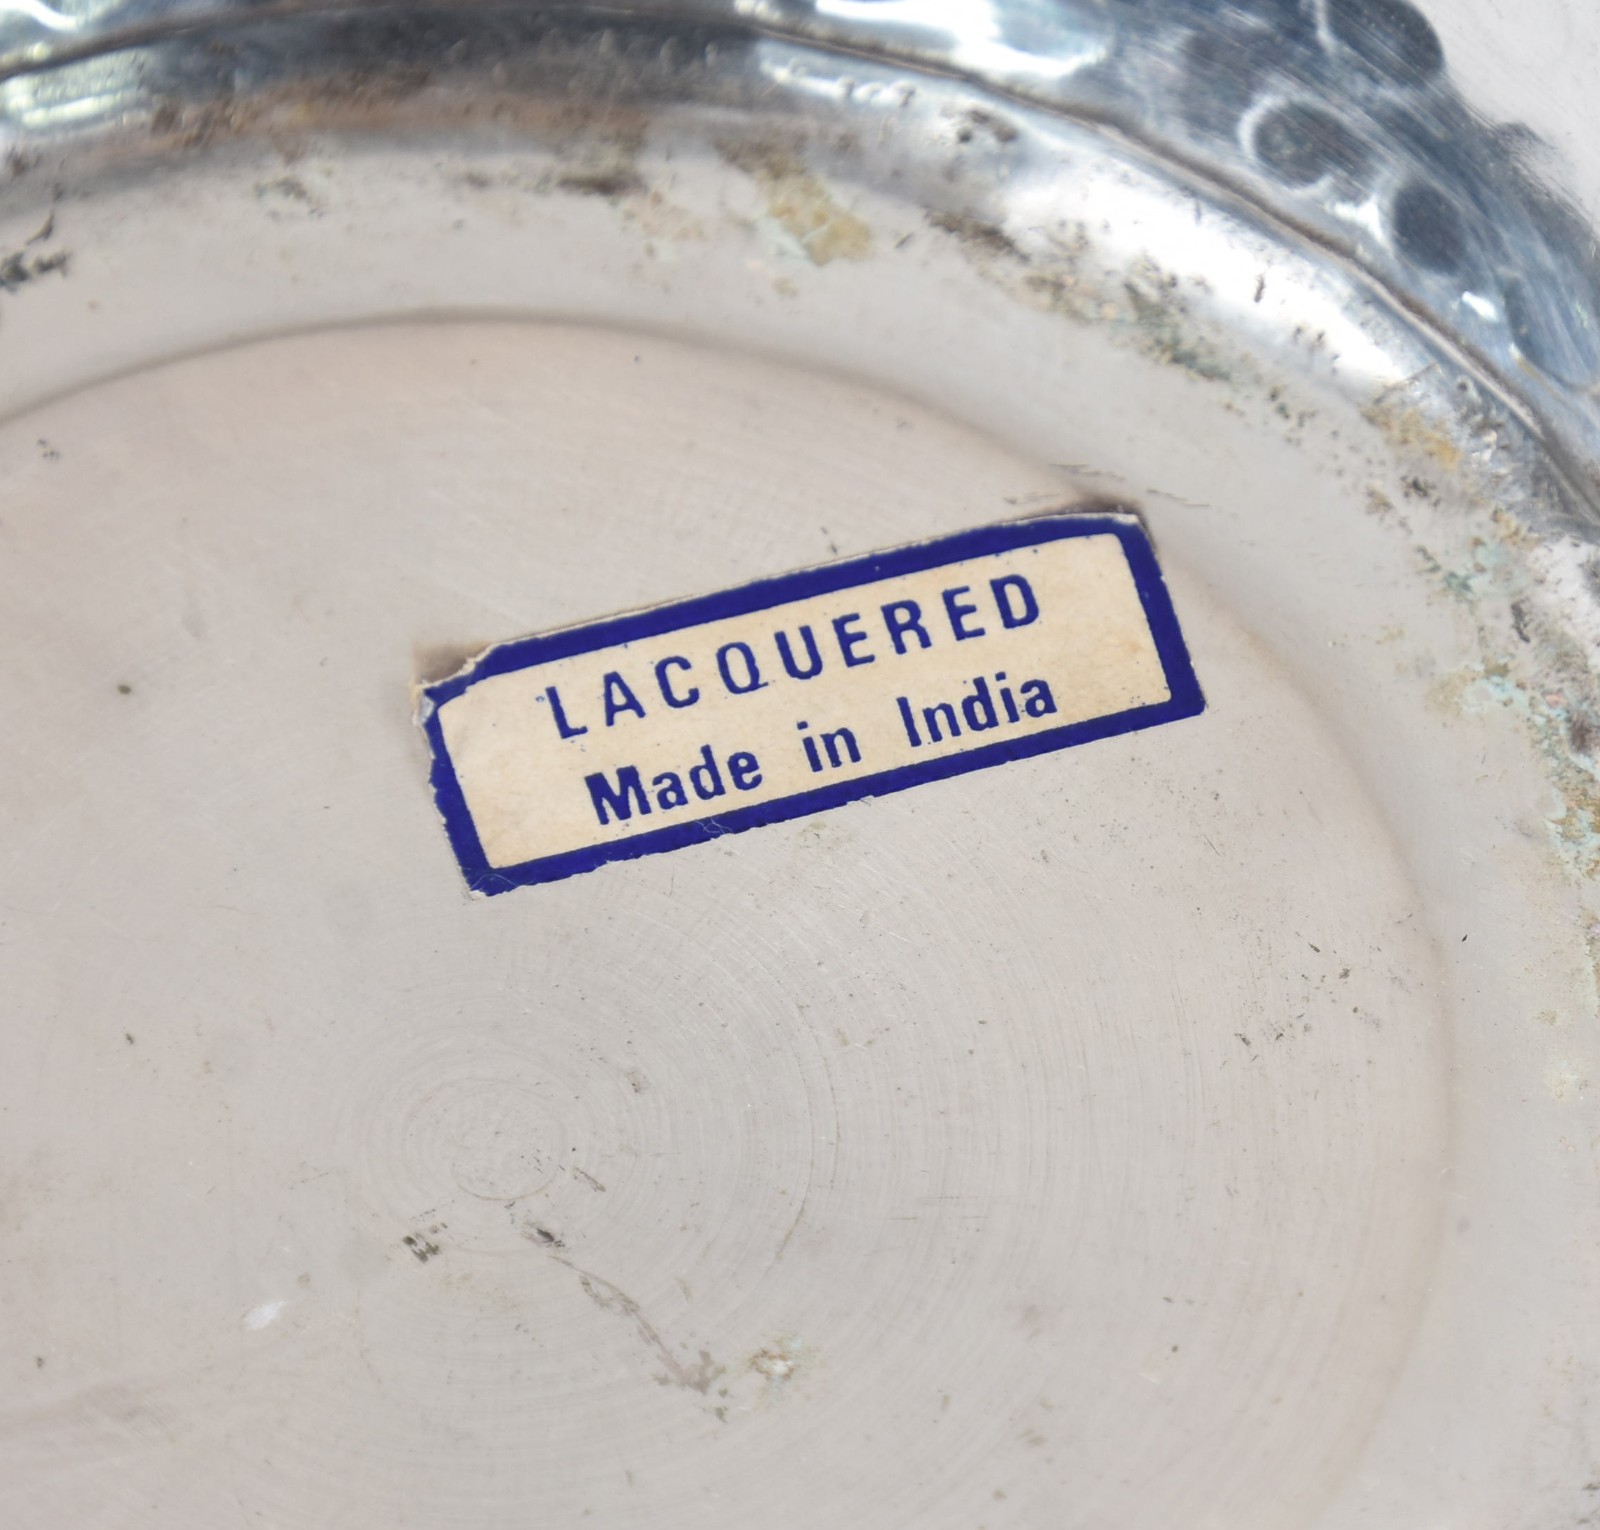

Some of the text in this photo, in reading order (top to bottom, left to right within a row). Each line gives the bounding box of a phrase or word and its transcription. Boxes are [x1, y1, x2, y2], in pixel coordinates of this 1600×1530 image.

[545, 574, 1040, 740] LACQUERED
[585, 671, 1058, 826] Made in India
